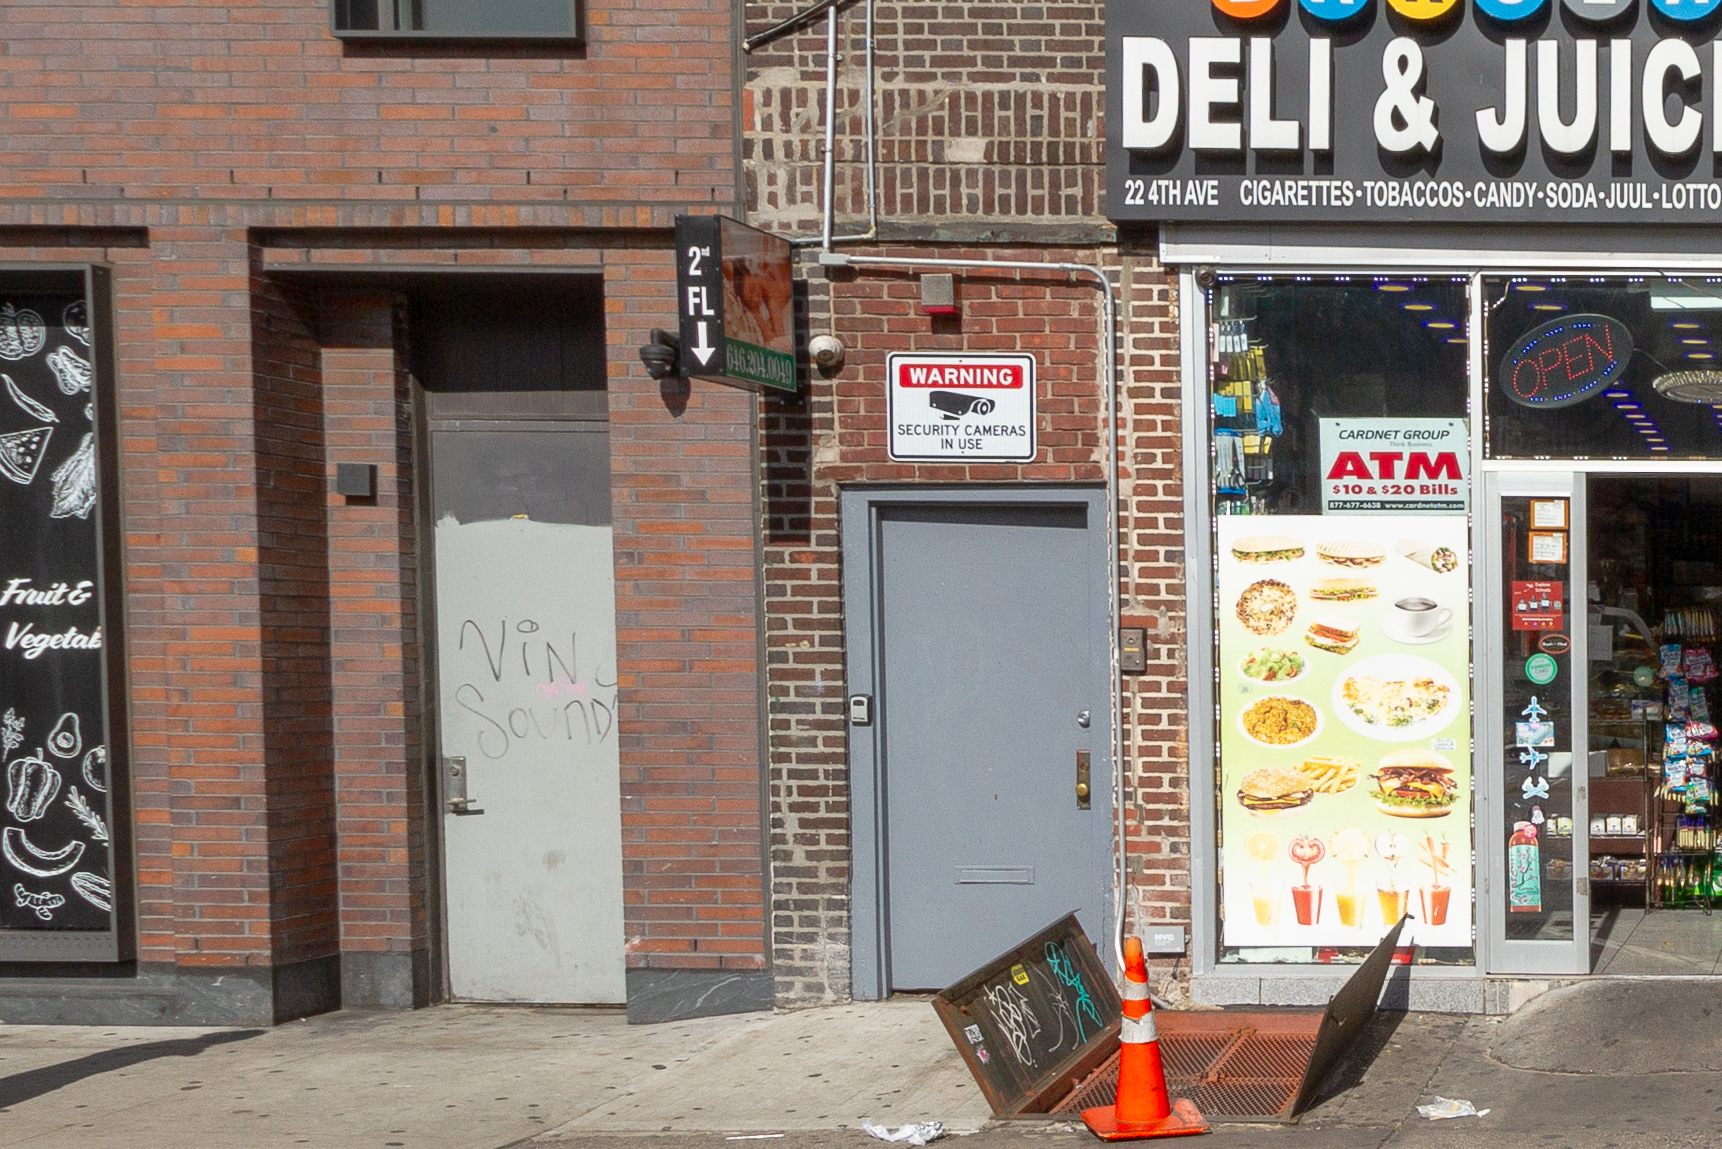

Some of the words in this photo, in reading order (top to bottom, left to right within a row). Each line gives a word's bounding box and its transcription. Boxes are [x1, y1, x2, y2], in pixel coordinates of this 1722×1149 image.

[1121, 36, 1332, 151] DELI
[1374, 36, 1441, 153] &
[1124, 180, 1145, 205] 22
[1148, 180, 1181, 205] 4TH
[1184, 180, 1219, 205] AVE
[687, 246, 710, 276] 2nd
[687, 286, 715, 316] FL
[726, 344, 793, 384] 646.204.0049
[1512, 324, 1614, 399] OPEN
[909, 367, 1013, 386] WARNING
[898, 424, 960, 436] SECURITY
[965, 424, 1026, 437] CAMERAS
[941, 438, 953, 449] IN
[958, 438, 983, 450] USE
[1338, 429, 1400, 440] CARDNET
[1403, 429, 1450, 440] GROUP
[1326, 451, 1463, 481] ATM
[1332, 484, 1363, 495] $10
[1366, 485, 1377, 495] &
[1381, 484, 1415, 495] $20
[1420, 484, 1458, 495] Bills
[0, 577, 71, 606] Fruit
[67, 580, 94, 606] &
